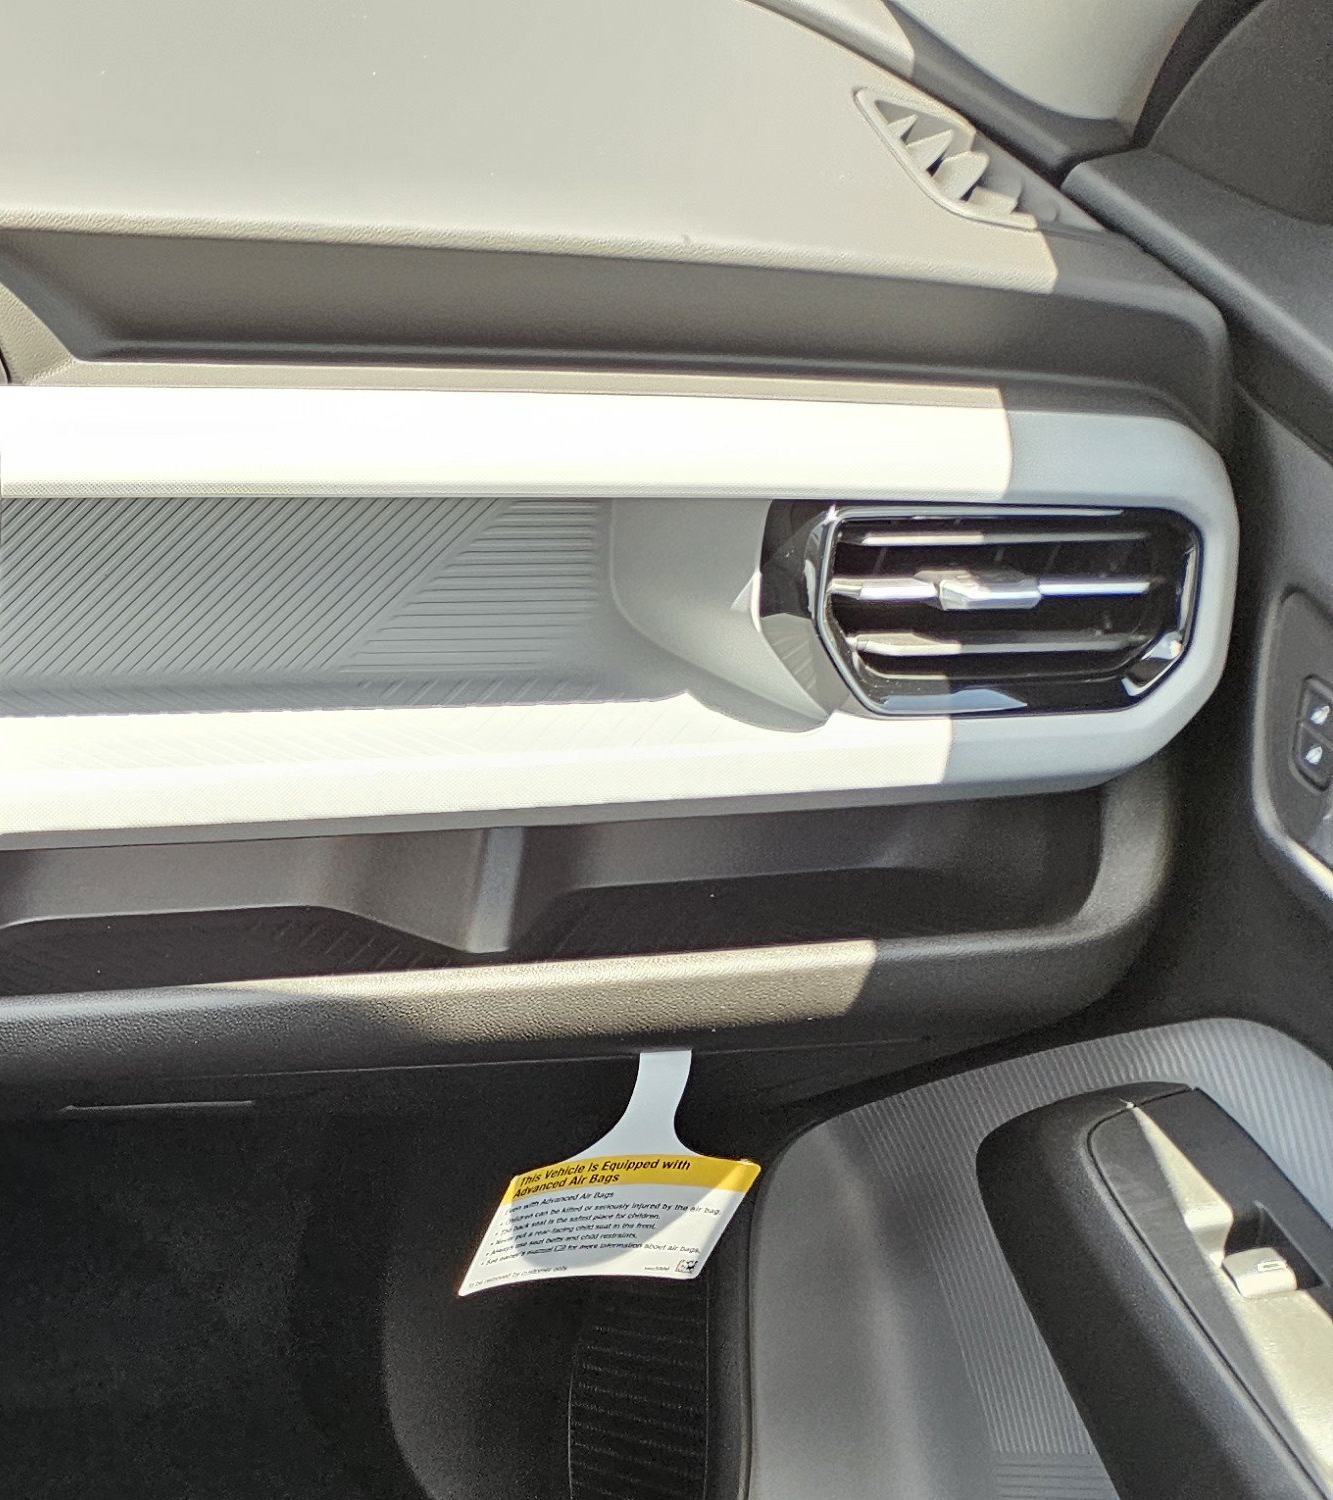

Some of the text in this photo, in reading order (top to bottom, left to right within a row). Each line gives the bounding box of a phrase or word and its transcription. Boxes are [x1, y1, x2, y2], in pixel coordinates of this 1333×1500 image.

[513, 1173, 620, 1198] Advanced Air Bags
[520, 1175, 541, 1187] This
[545, 1164, 585, 1179] Vehicle
[601, 1159, 660, 1173] Equipped
[662, 1160, 691, 1171] with
[540, 1194, 578, 1205] Advanced
